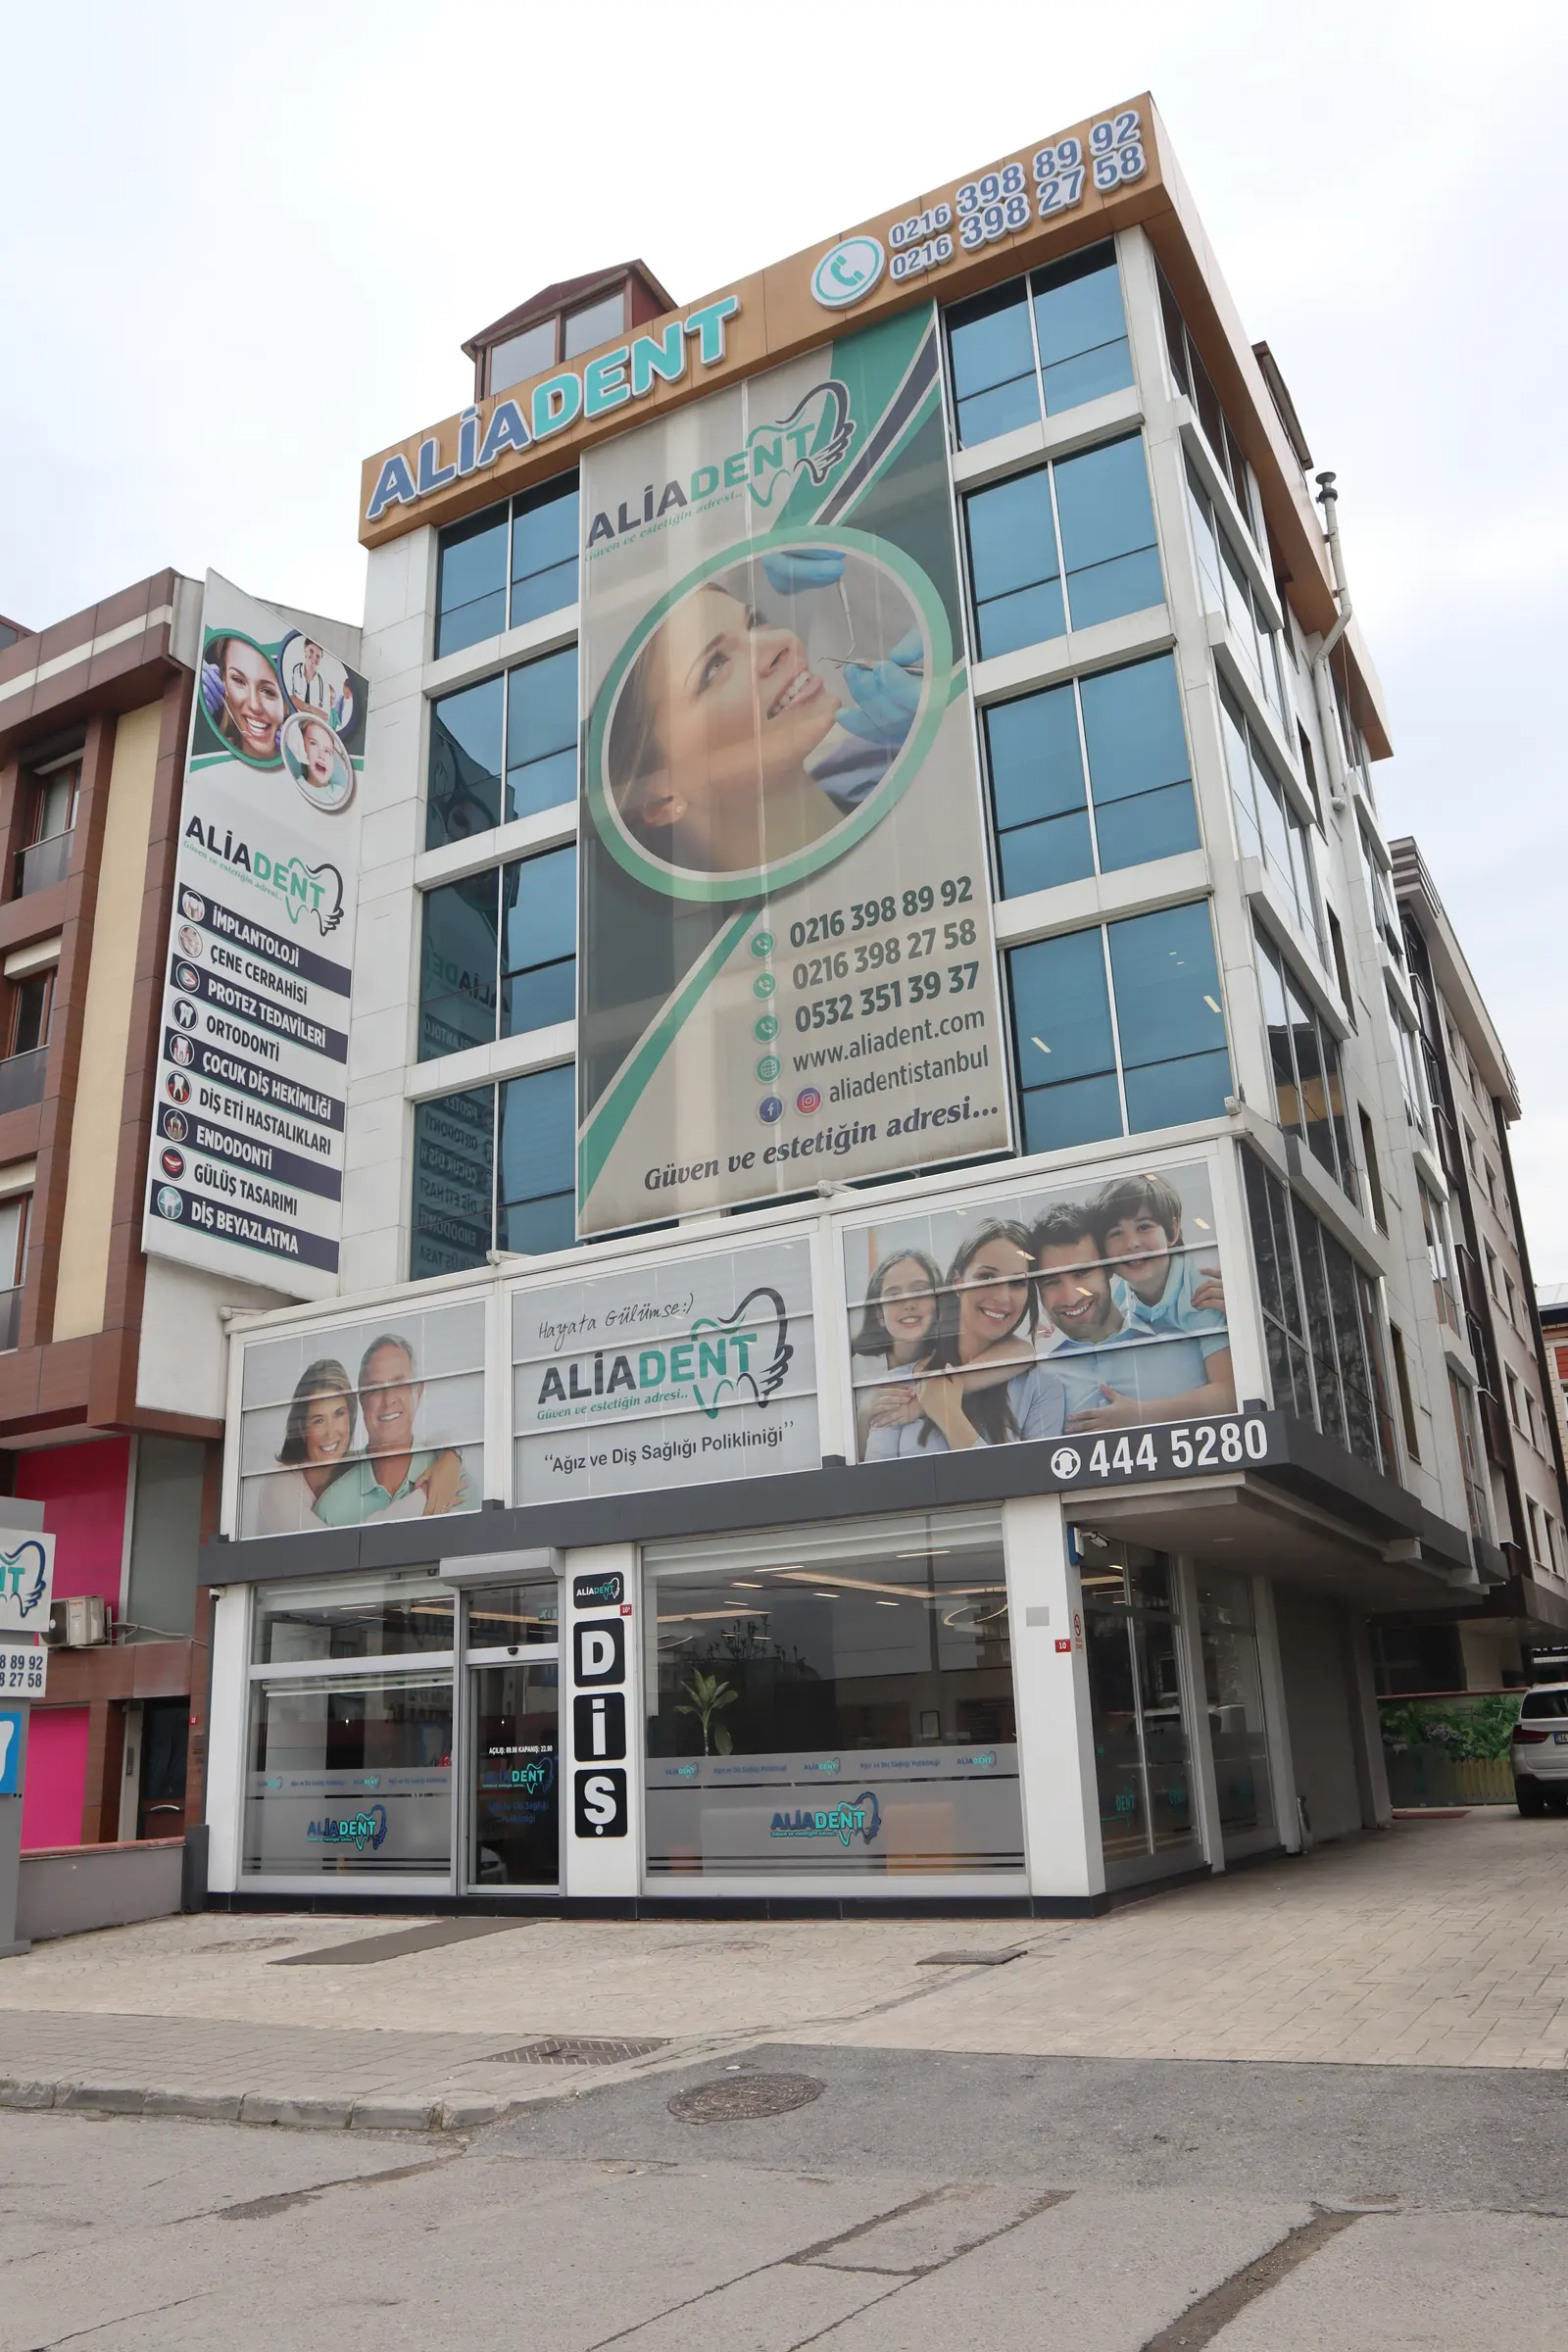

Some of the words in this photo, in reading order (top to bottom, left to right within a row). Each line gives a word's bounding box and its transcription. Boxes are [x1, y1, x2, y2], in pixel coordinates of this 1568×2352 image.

[890, 204, 952, 248] 0216
[956, 163, 1026, 217] 398
[1034, 138, 1082, 181] 89
[1090, 110, 1141, 155] 92
[890, 234, 954, 282] 0216
[960, 193, 1030, 252] 398
[1037, 167, 1086, 219] 27
[1093, 143, 1146, 192] 58
[366, 295, 742, 522] ALİADENT
[585, 423, 815, 549] ALİADENT
[185, 815, 325, 909] ALİADENT
[212, 905, 300, 967] İMPLANTOLOJİ
[790, 909, 844, 948] 0216
[851, 896, 896, 931] 398
[903, 886, 934, 918] 89
[940, 875, 973, 907] 92
[210, 945, 242, 974] ÇENE
[246, 961, 308, 1005] CERRAHİSİ
[792, 952, 849, 990] 0216
[855, 937, 901, 973] 398
[906, 927, 936, 960] 27
[944, 917, 977, 951] 58
[208, 979, 257, 1016] PROTEZ
[259, 1003, 326, 1049] TEDAVİLERİ
[795, 994, 854, 1033] 0532
[860, 978, 903, 1015] 351
[908, 971, 942, 1004] 39
[948, 960, 980, 995] 37
[206, 1015, 280, 1062] ORTODONTİ
[793, 1009, 986, 1073] www.aliadent.com
[202, 1052, 247, 1086] ÇOCUK
[248, 1070, 270, 1097] DİŞ
[271, 1085, 332, 1121] HEKİMLİĞİ
[829, 1045, 990, 1103] aliadentistanbul
[196, 1125, 273, 1170] ENDODONTİ
[199, 1087, 221, 1114] DİŞ
[223, 1099, 244, 1121] ETİ
[246, 1107, 331, 1155] HASTALIKLARI
[644, 1158, 719, 1191] Güven
[728, 1149, 755, 1172] ve
[762, 1122, 877, 1163] estetiğin
[194, 1163, 236, 1197] GÜLÜŞ
[240, 1181, 298, 1216] TASARIMI
[191, 1200, 215, 1229] DİŞ
[217, 1209, 299, 1254] BEYAZLATMA
[538, 1316, 597, 1351] Hayata
[538, 1333, 758, 1404] ALİADENT
[537, 1405, 571, 1421] Güven
[574, 1404, 587, 1415] ve
[590, 1394, 641, 1413] estetiğin
[590, 1452, 608, 1467] ve
[612, 1447, 637, 1466] Diş
[642, 1442, 697, 1461] Sağlığı
[1089, 1433, 1157, 1478] 444
[1171, 1419, 1268, 1469] 5280
[576, 1585, 614, 1596] ALİADENT
[9, 1673, 24, 1688] 27
[27, 1673, 42, 1688] 58
[10, 1655, 24, 1670] 89
[28, 1656, 43, 1670] 92
